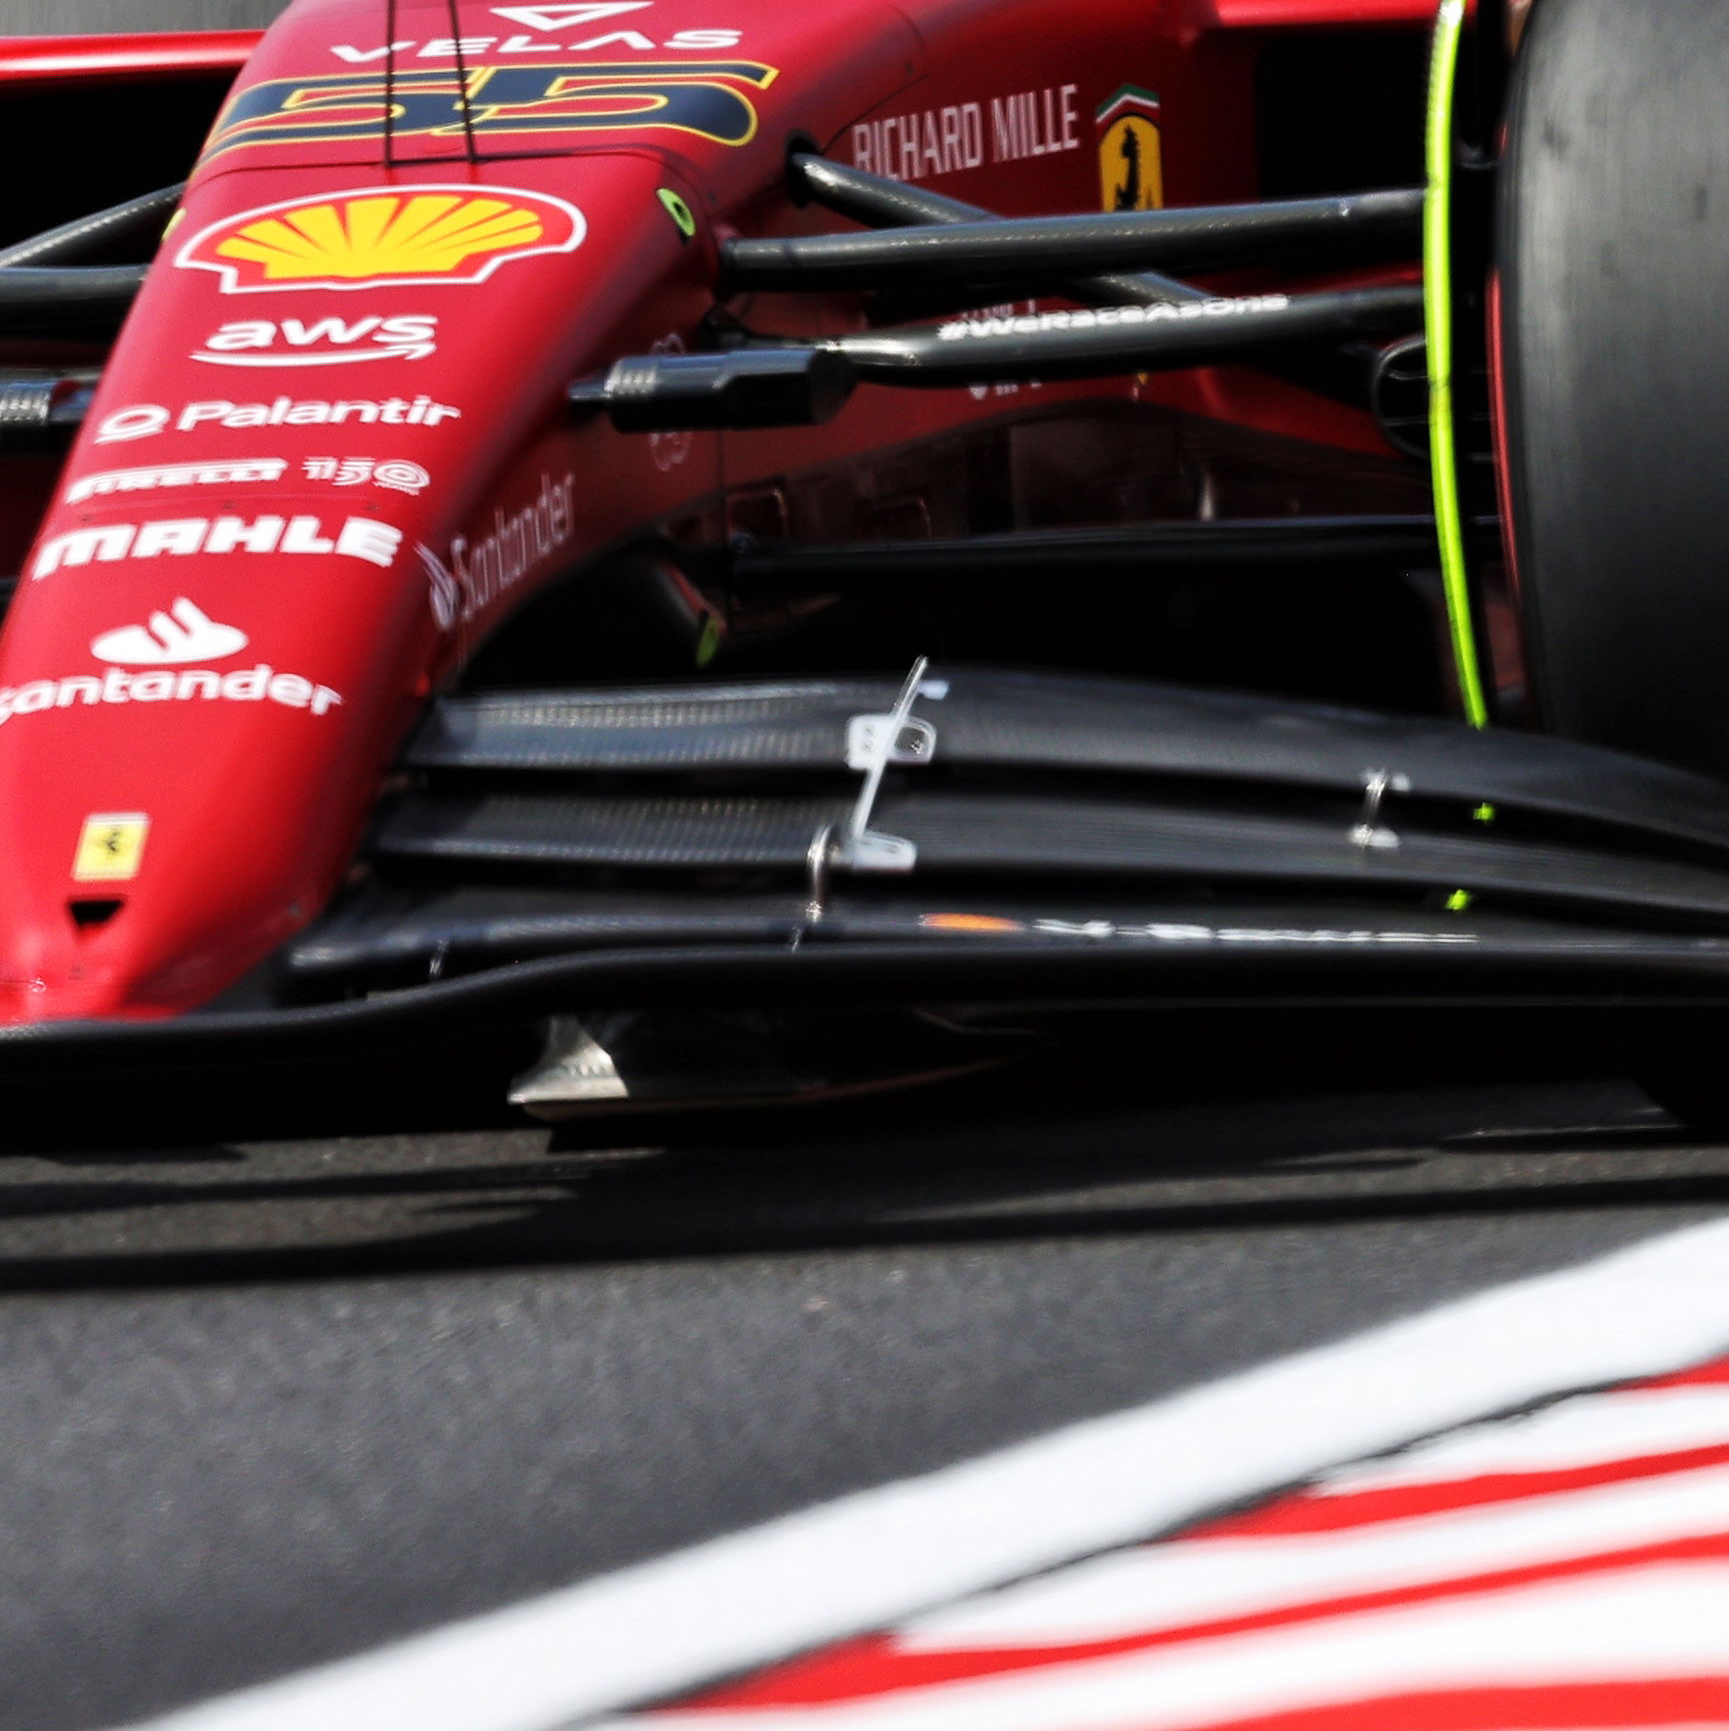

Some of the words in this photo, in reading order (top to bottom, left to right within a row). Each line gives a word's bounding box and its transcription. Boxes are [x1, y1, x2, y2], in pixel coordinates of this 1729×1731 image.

[330, 29, 744, 63] VELAS
[192, 59, 780, 174] 55
[853, 101, 983, 181] RICHARD
[990, 83, 1080, 163] MILLE
[206, 315, 439, 348] aws
[937, 294, 1290, 341] #WeRaceAsOne
[177, 395, 461, 431] Palantir
[65, 457, 289, 505] PIRELLI
[31, 515, 404, 581] MAHLE
[452, 472, 575, 622] Santander
